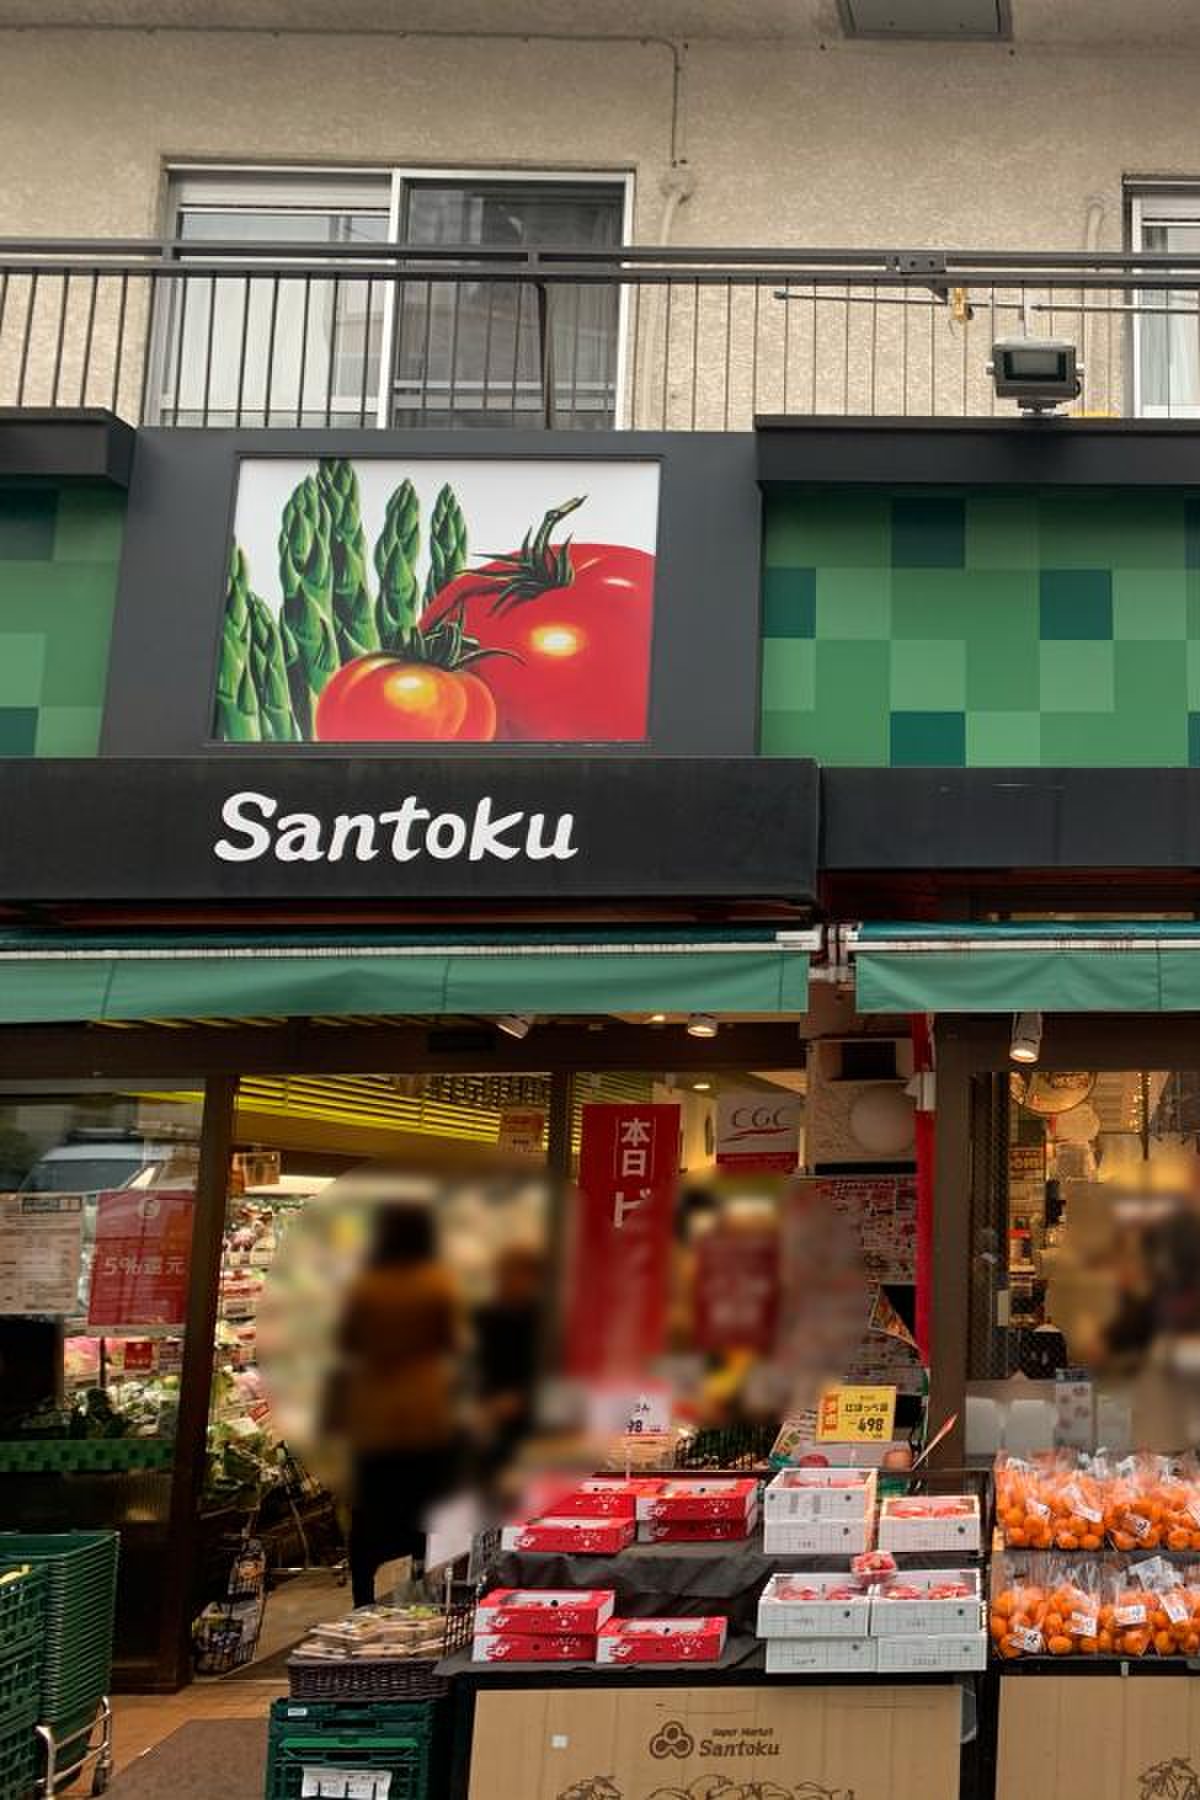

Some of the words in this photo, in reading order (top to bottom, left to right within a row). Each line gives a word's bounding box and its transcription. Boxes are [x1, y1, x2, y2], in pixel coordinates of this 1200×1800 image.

[213, 791, 579, 863] Santoku
[731, 1107, 790, 1129] CGC
[621, 1118, 651, 1179] 本日
[857, 1417, 885, 1432] 498
[699, 1739, 780, 1757] Santoku
